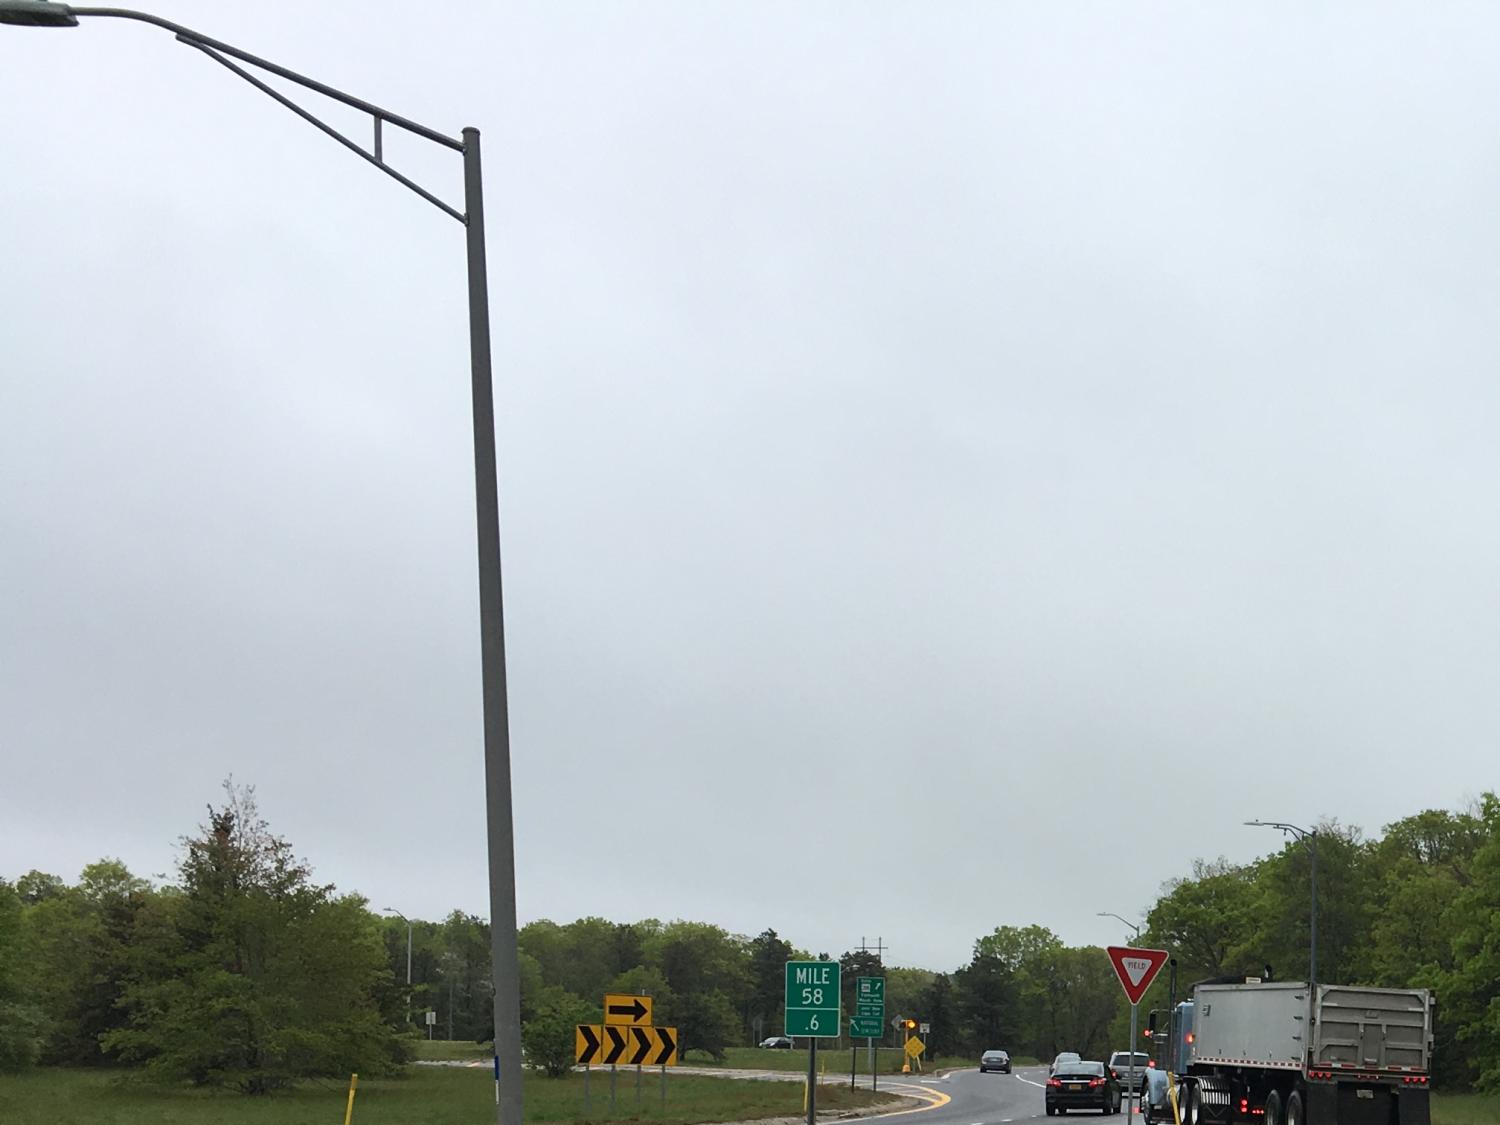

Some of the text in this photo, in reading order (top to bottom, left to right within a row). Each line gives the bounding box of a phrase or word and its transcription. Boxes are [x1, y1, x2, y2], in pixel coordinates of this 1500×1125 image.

[796, 967, 830, 985] MILE
[802, 988, 823, 1005] 58
[805, 1014, 819, 1031] .6
